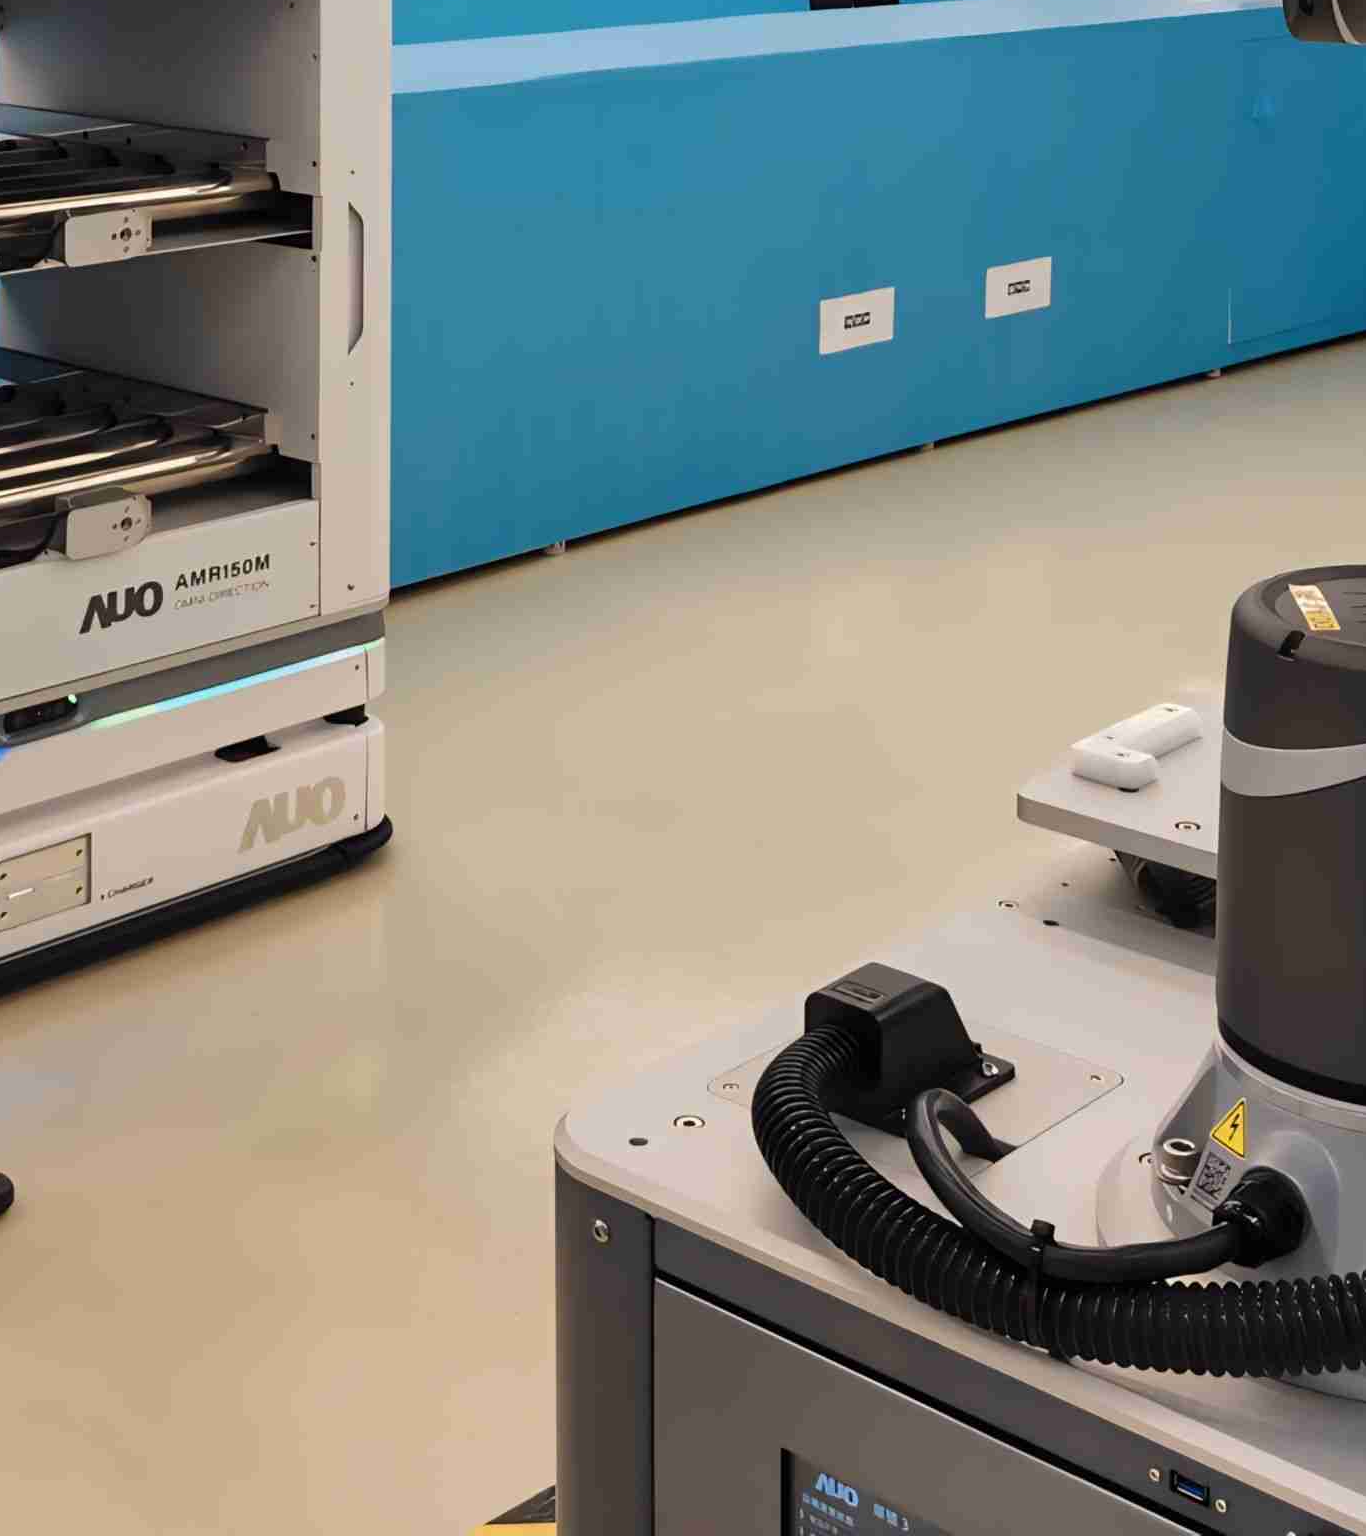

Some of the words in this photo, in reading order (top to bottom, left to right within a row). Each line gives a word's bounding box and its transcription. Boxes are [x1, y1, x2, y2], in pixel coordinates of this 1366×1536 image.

[175, 553, 270, 591] AMR150M
[79, 581, 164, 635] AUO
[239, 776, 347, 854] AUO
[816, 1472, 859, 1506] AUO
